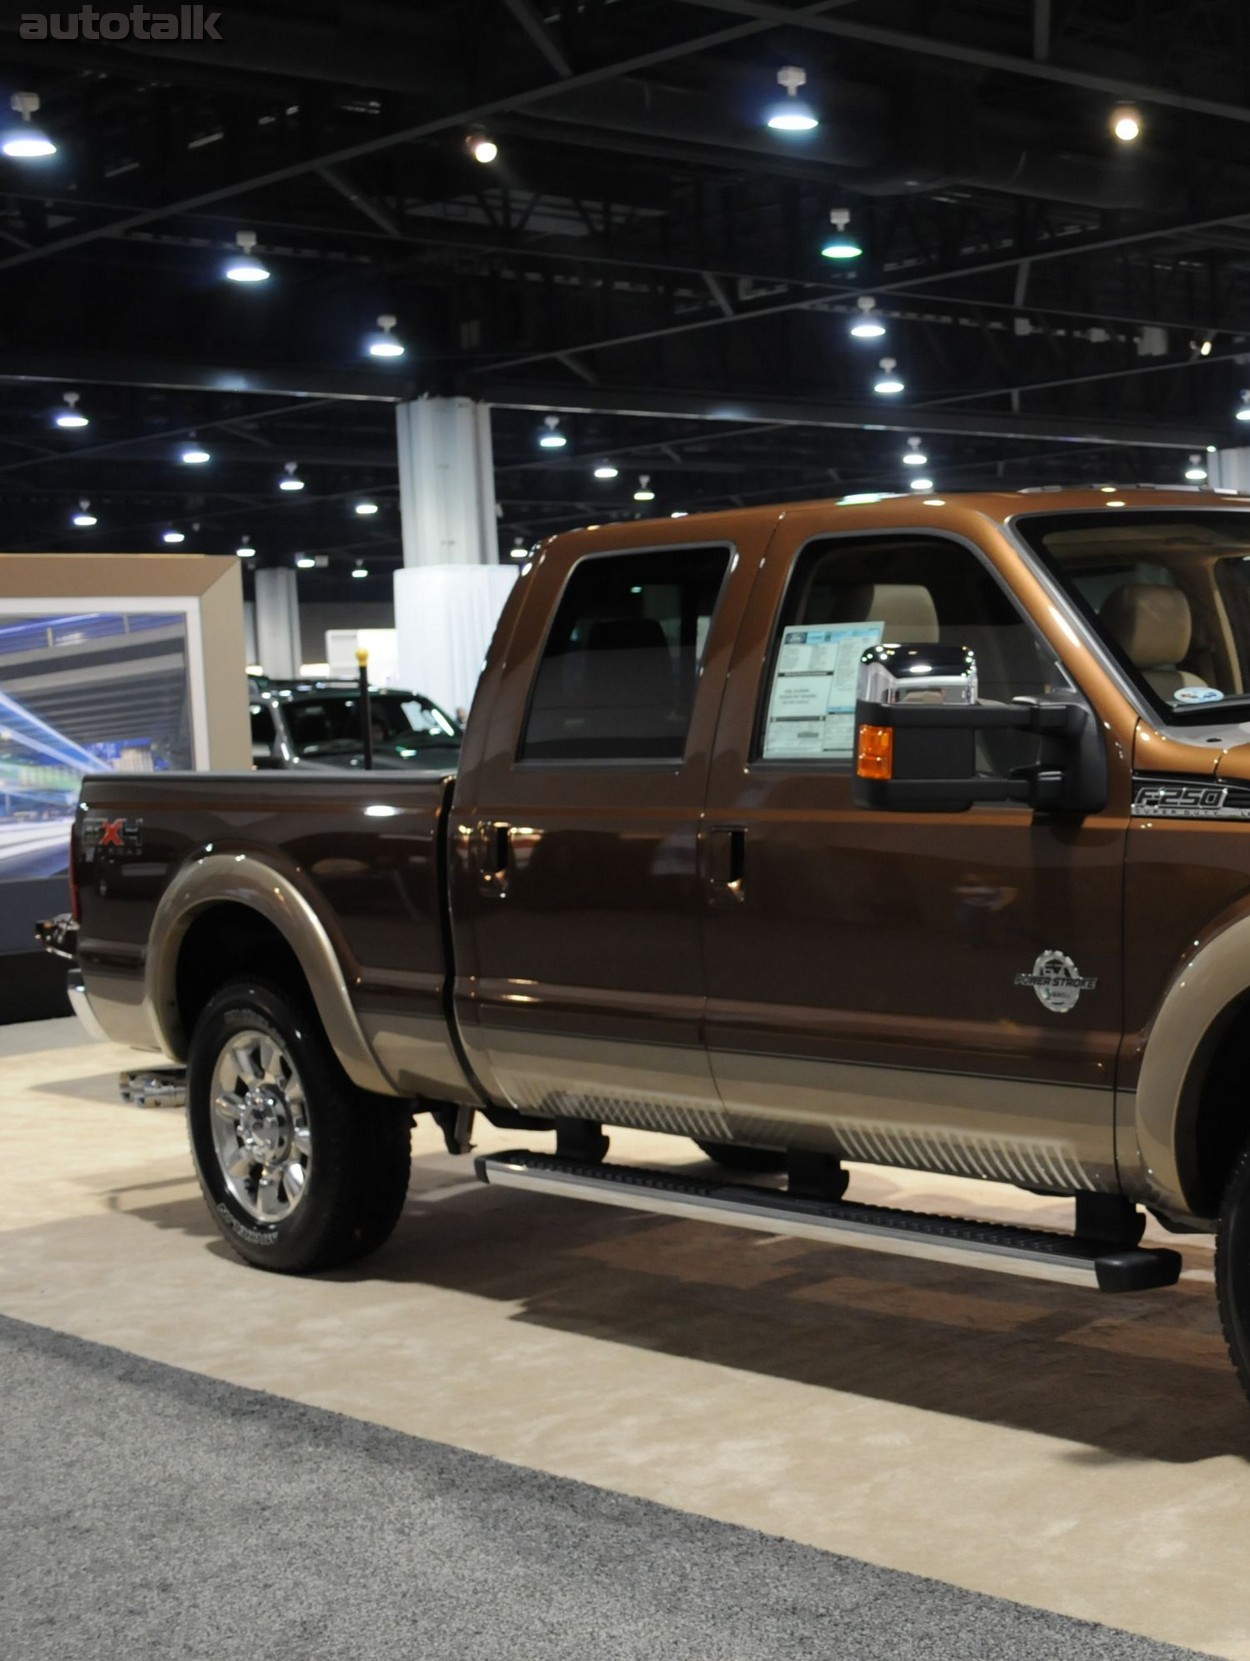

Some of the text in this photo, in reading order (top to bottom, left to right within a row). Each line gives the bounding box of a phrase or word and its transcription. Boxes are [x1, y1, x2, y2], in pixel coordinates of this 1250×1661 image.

[1134, 809, 1177, 817] SUPER
[1014, 972, 1098, 990] POWER STROKE
